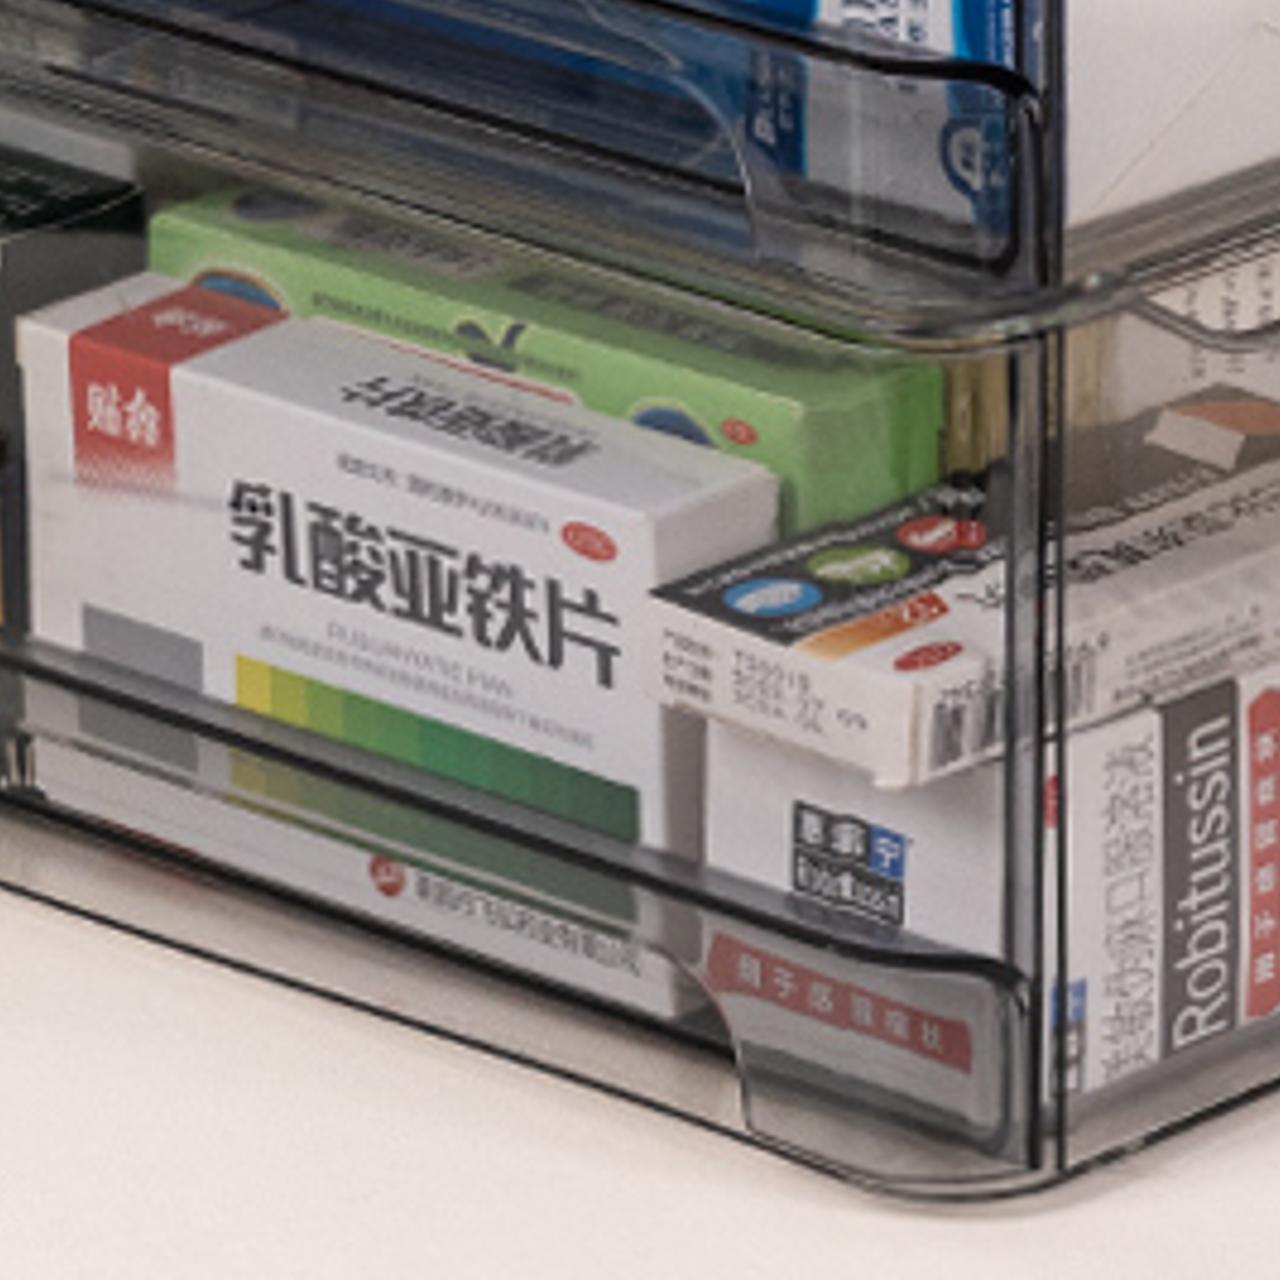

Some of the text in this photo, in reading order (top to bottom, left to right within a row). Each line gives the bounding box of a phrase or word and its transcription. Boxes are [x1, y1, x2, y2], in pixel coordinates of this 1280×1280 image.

[227, 479, 621, 690] 乳酸亚铁片
[1172, 713, 1230, 1048] Robitussin
